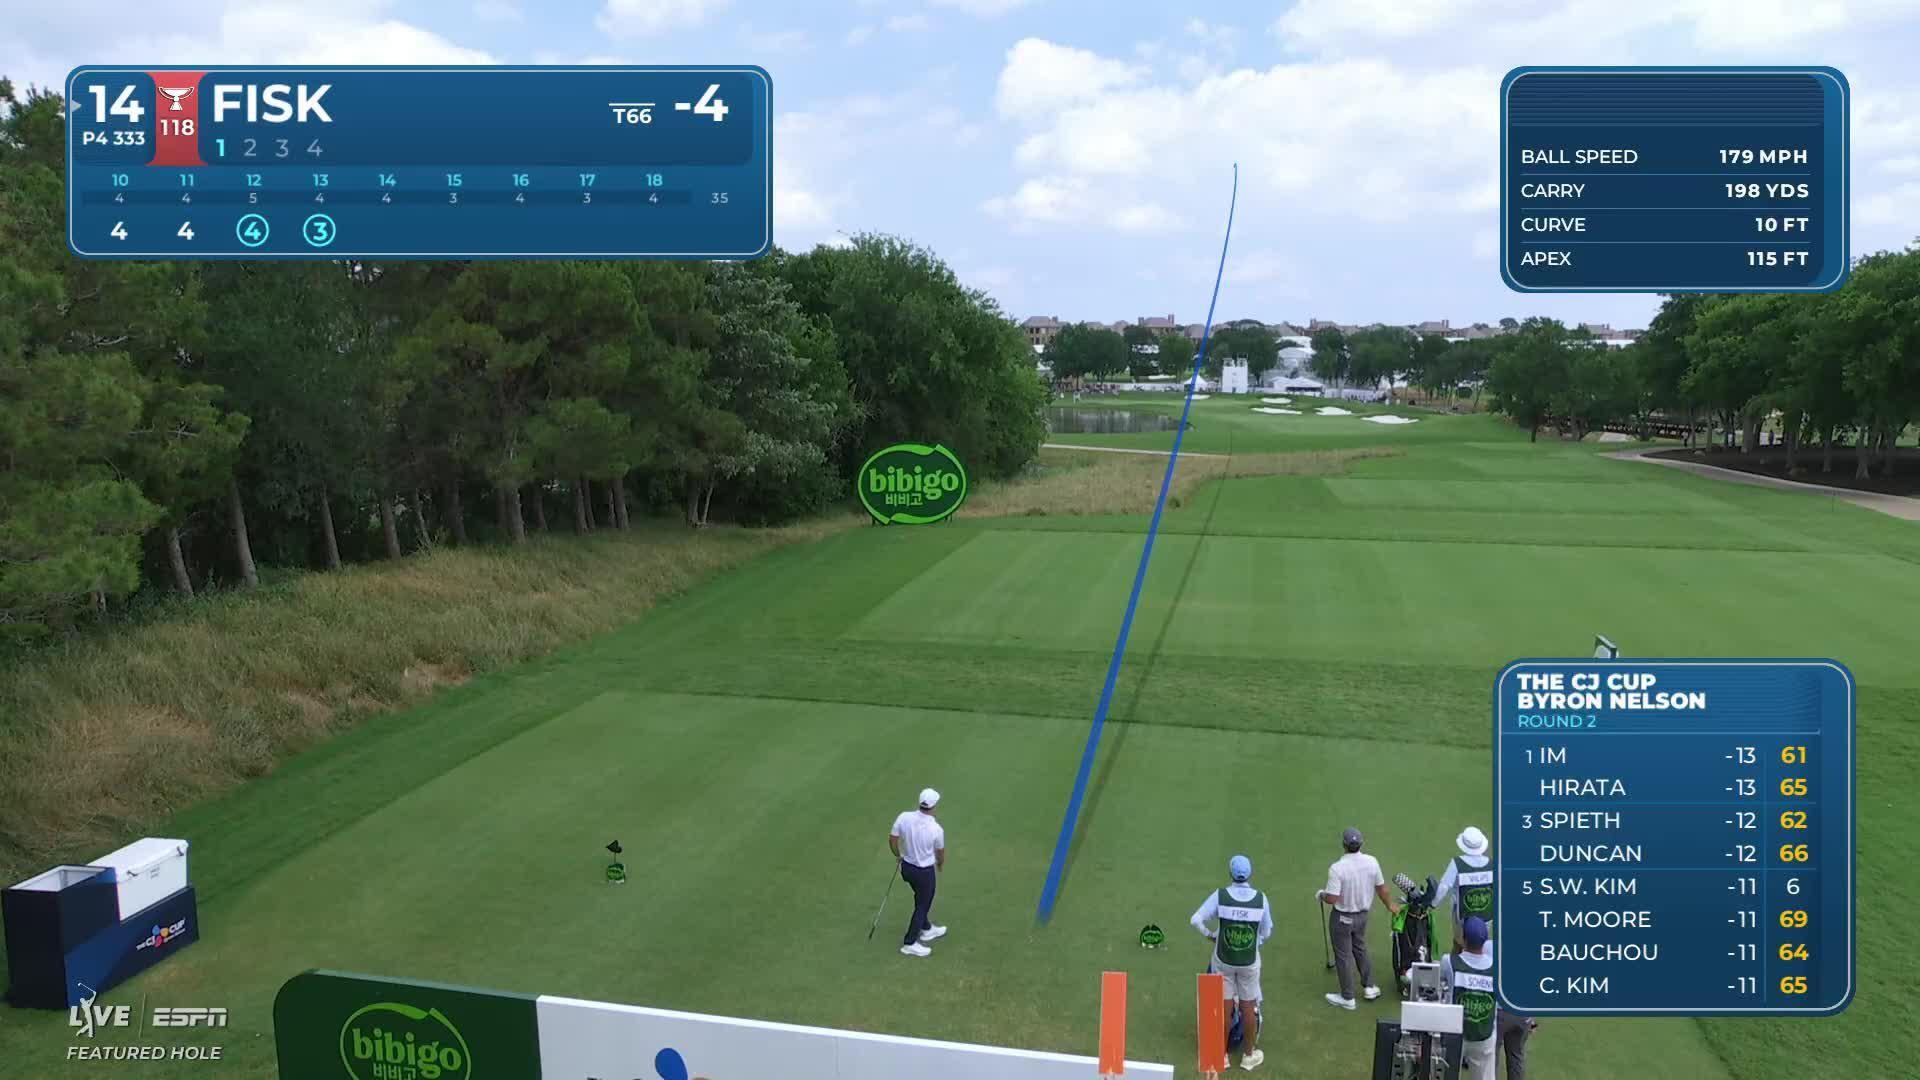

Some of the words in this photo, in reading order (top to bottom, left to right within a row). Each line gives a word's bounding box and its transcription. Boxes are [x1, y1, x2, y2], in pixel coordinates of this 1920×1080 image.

[869, 465, 959, 500] bibigo
[885, 493, 923, 507] 비비고
[1232, 909, 1249, 919] FISK
[352, 1028, 462, 1080] bibigo
